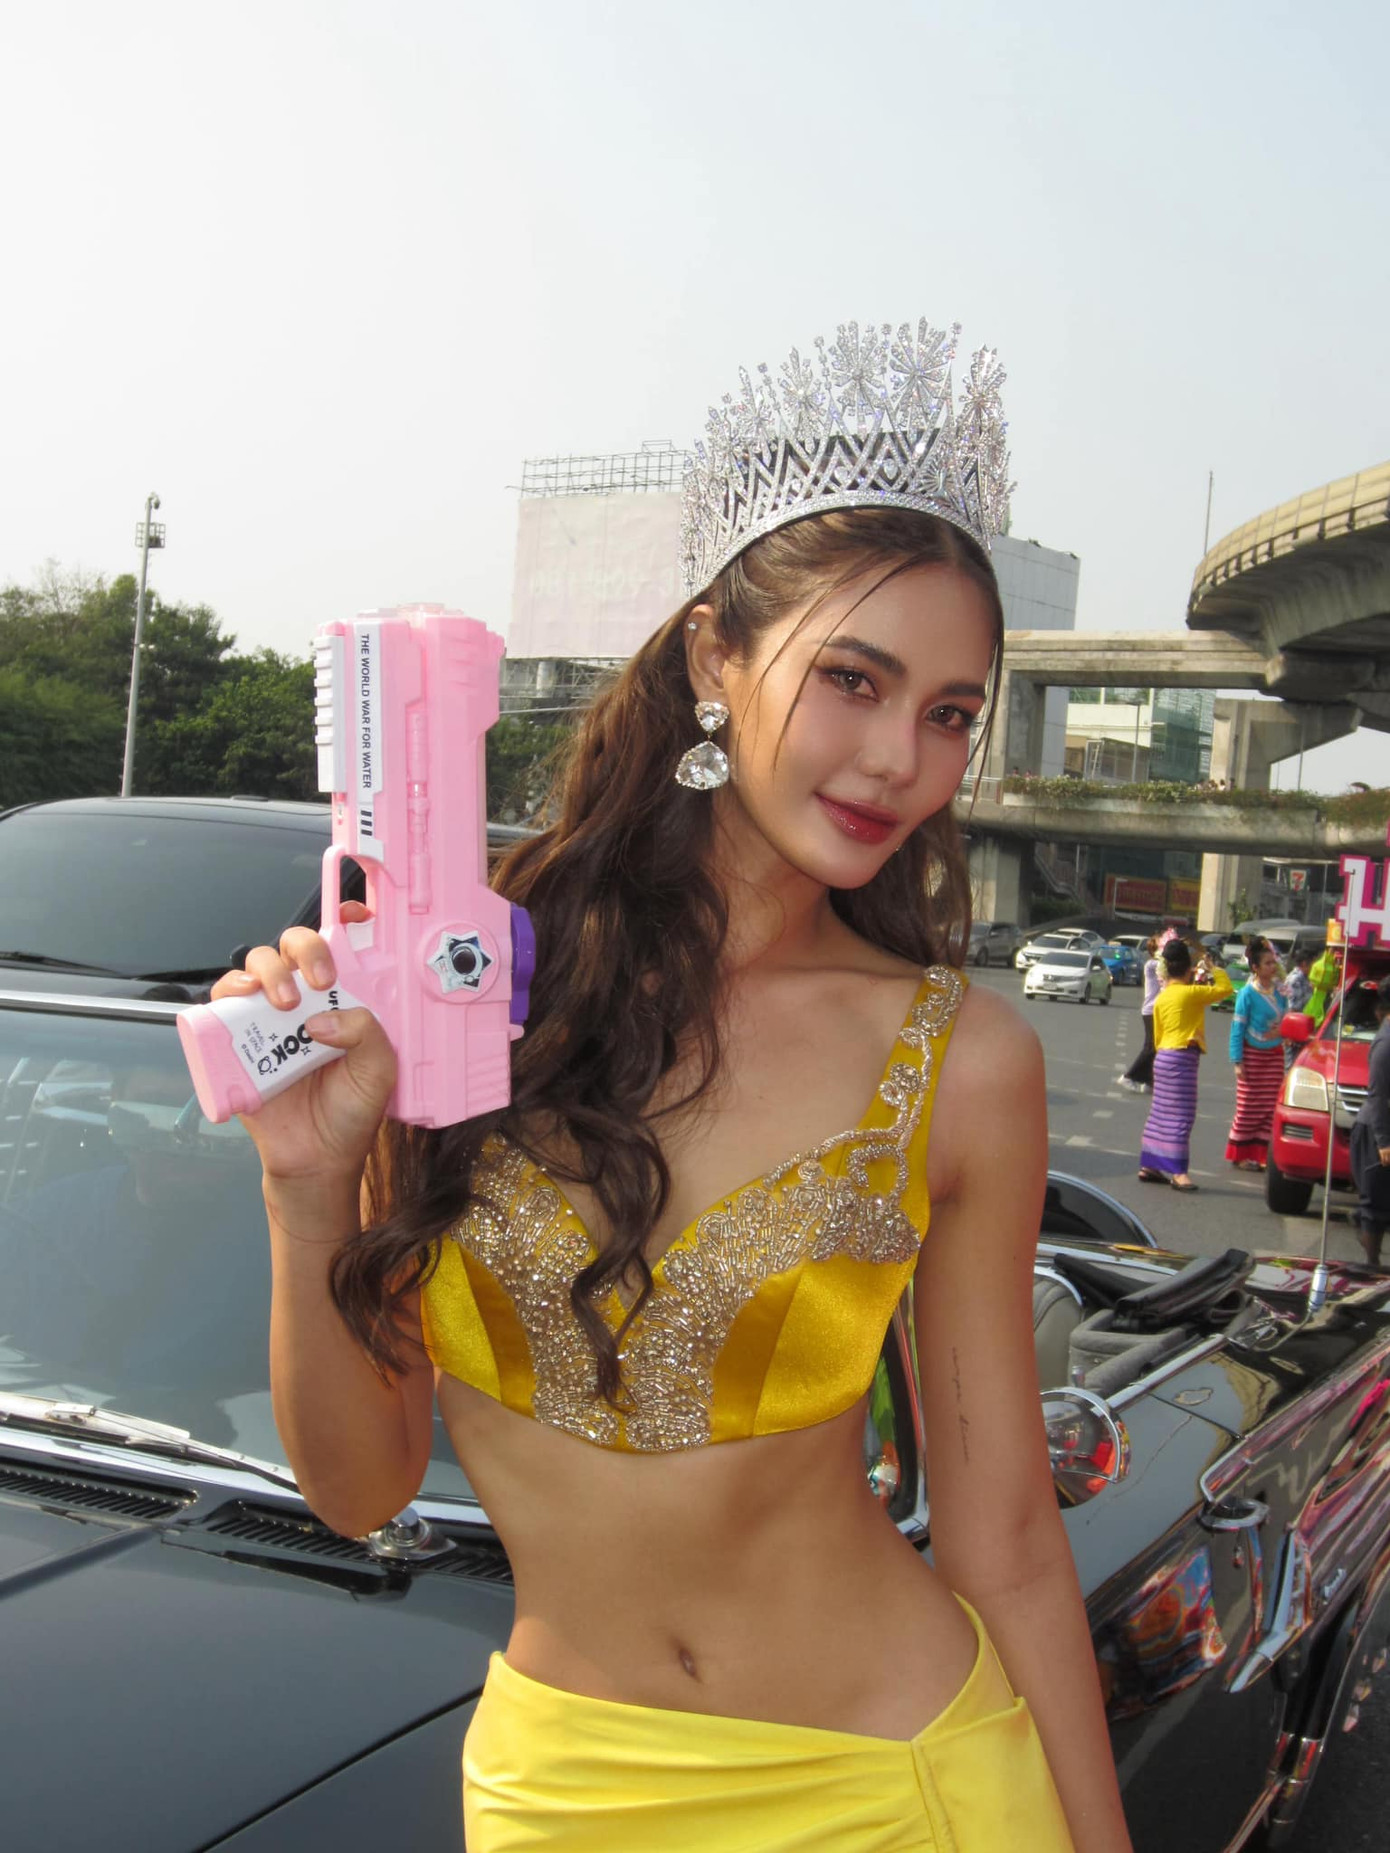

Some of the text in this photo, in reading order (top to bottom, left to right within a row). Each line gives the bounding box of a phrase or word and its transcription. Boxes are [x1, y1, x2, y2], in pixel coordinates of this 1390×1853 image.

[361, 633, 372, 789] THE WORLD WAR FOR WATER
[270, 1023, 314, 1066] OCK
